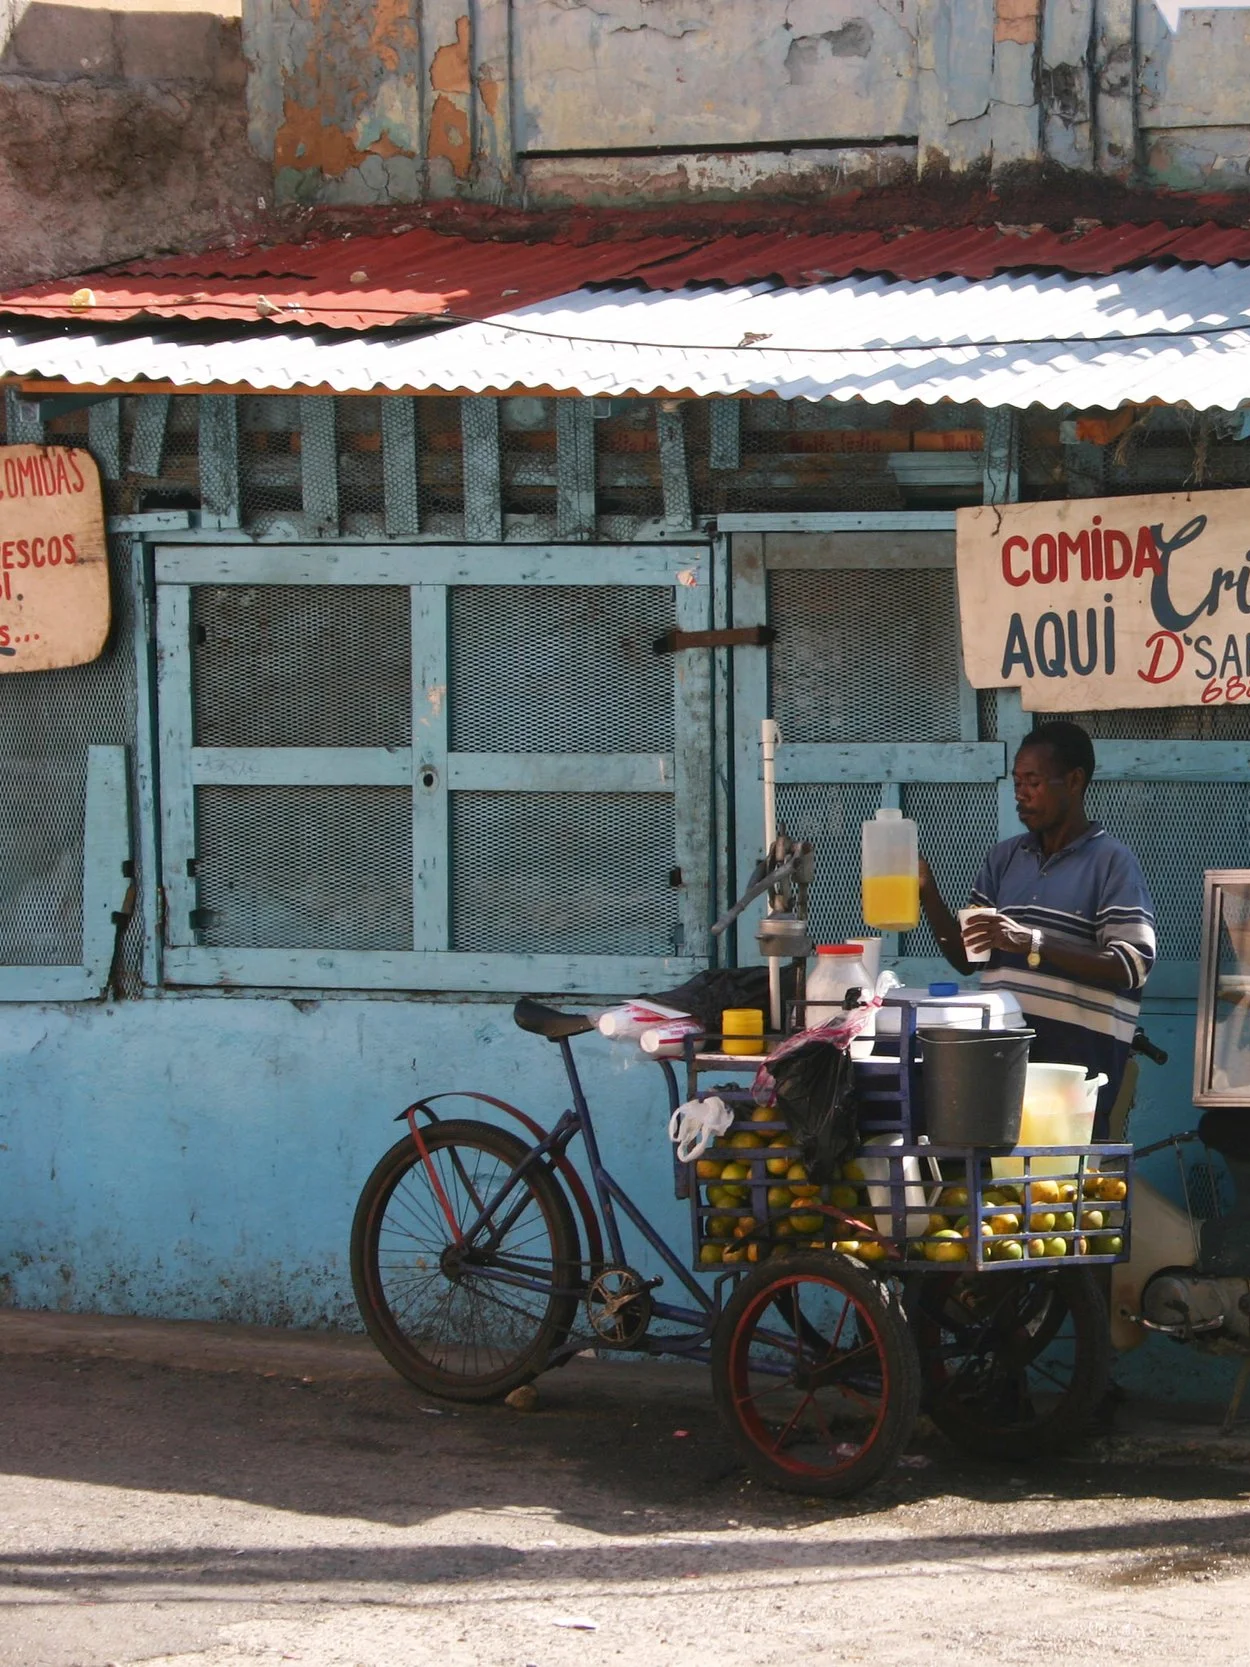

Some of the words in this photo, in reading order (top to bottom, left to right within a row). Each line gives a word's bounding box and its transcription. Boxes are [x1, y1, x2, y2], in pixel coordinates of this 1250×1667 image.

[0, 452, 84, 498] OMIDAS
[1001, 515, 1163, 586] COMIDA
[1001, 593, 1115, 679] AQUI
